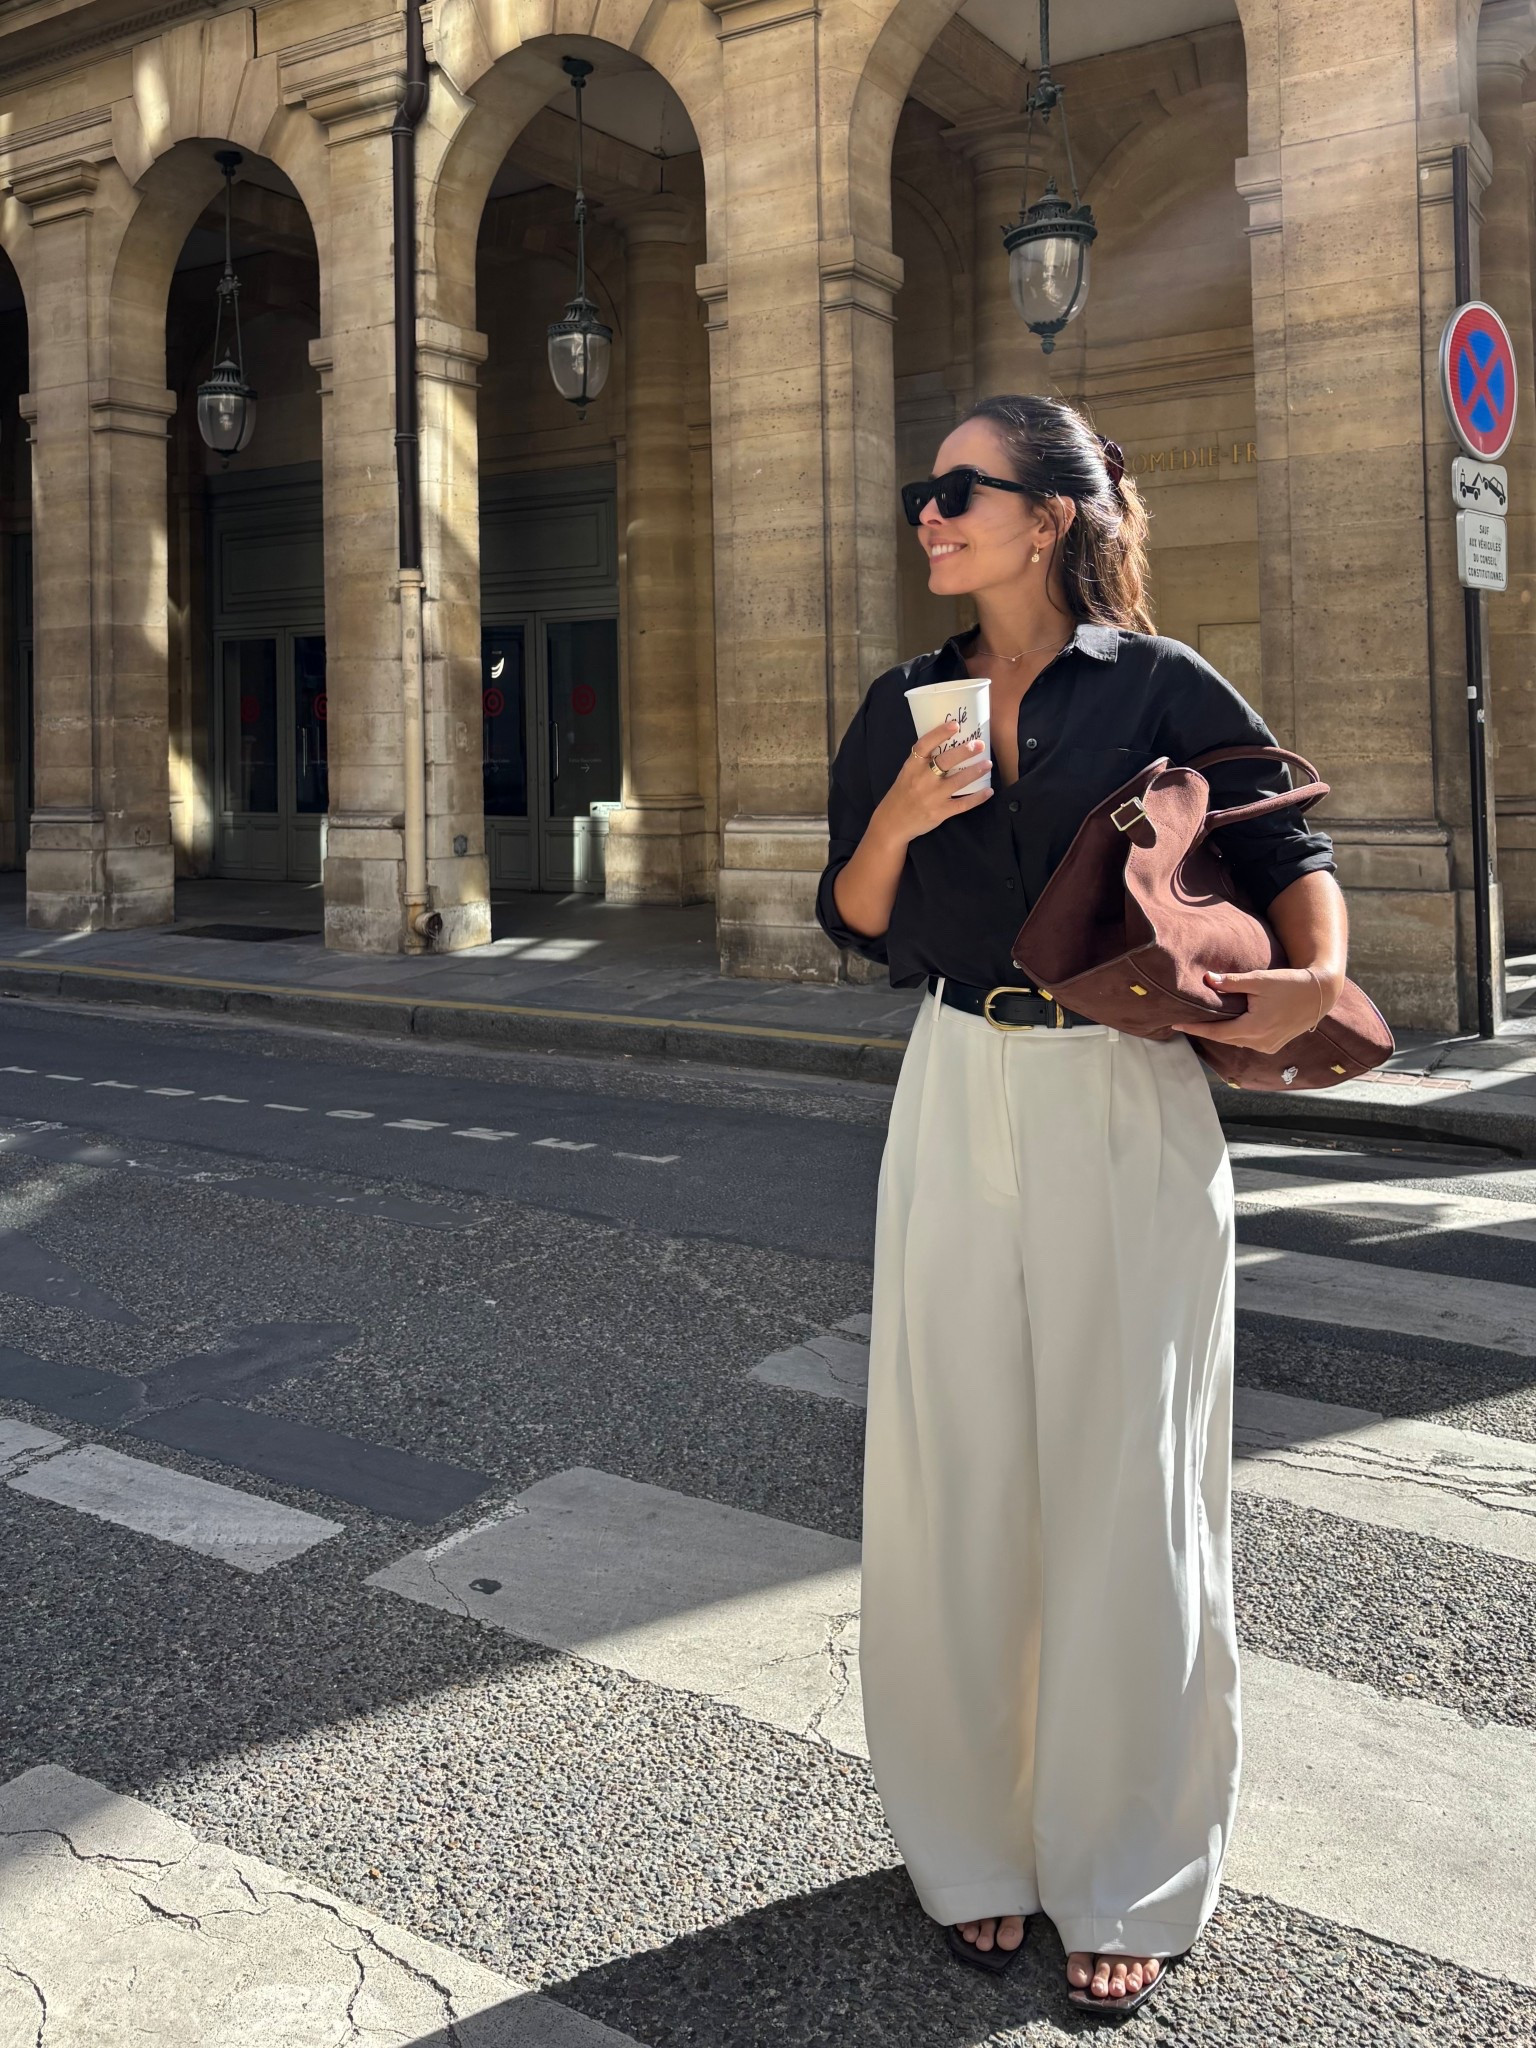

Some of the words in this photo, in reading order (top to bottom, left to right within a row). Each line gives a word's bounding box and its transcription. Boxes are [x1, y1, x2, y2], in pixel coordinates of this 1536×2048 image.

[1479, 524, 1489, 535] SAUF
[1469, 537, 1477, 548] AUX
[1478, 538, 1502, 552] VÉHICULES
[1473, 553, 1479, 563] DU
[1480, 554, 1497, 566] CONSEIL
[1468, 566, 1504, 582] CONSTITUTIONNEL
[944, 706, 968, 733] Cfé
